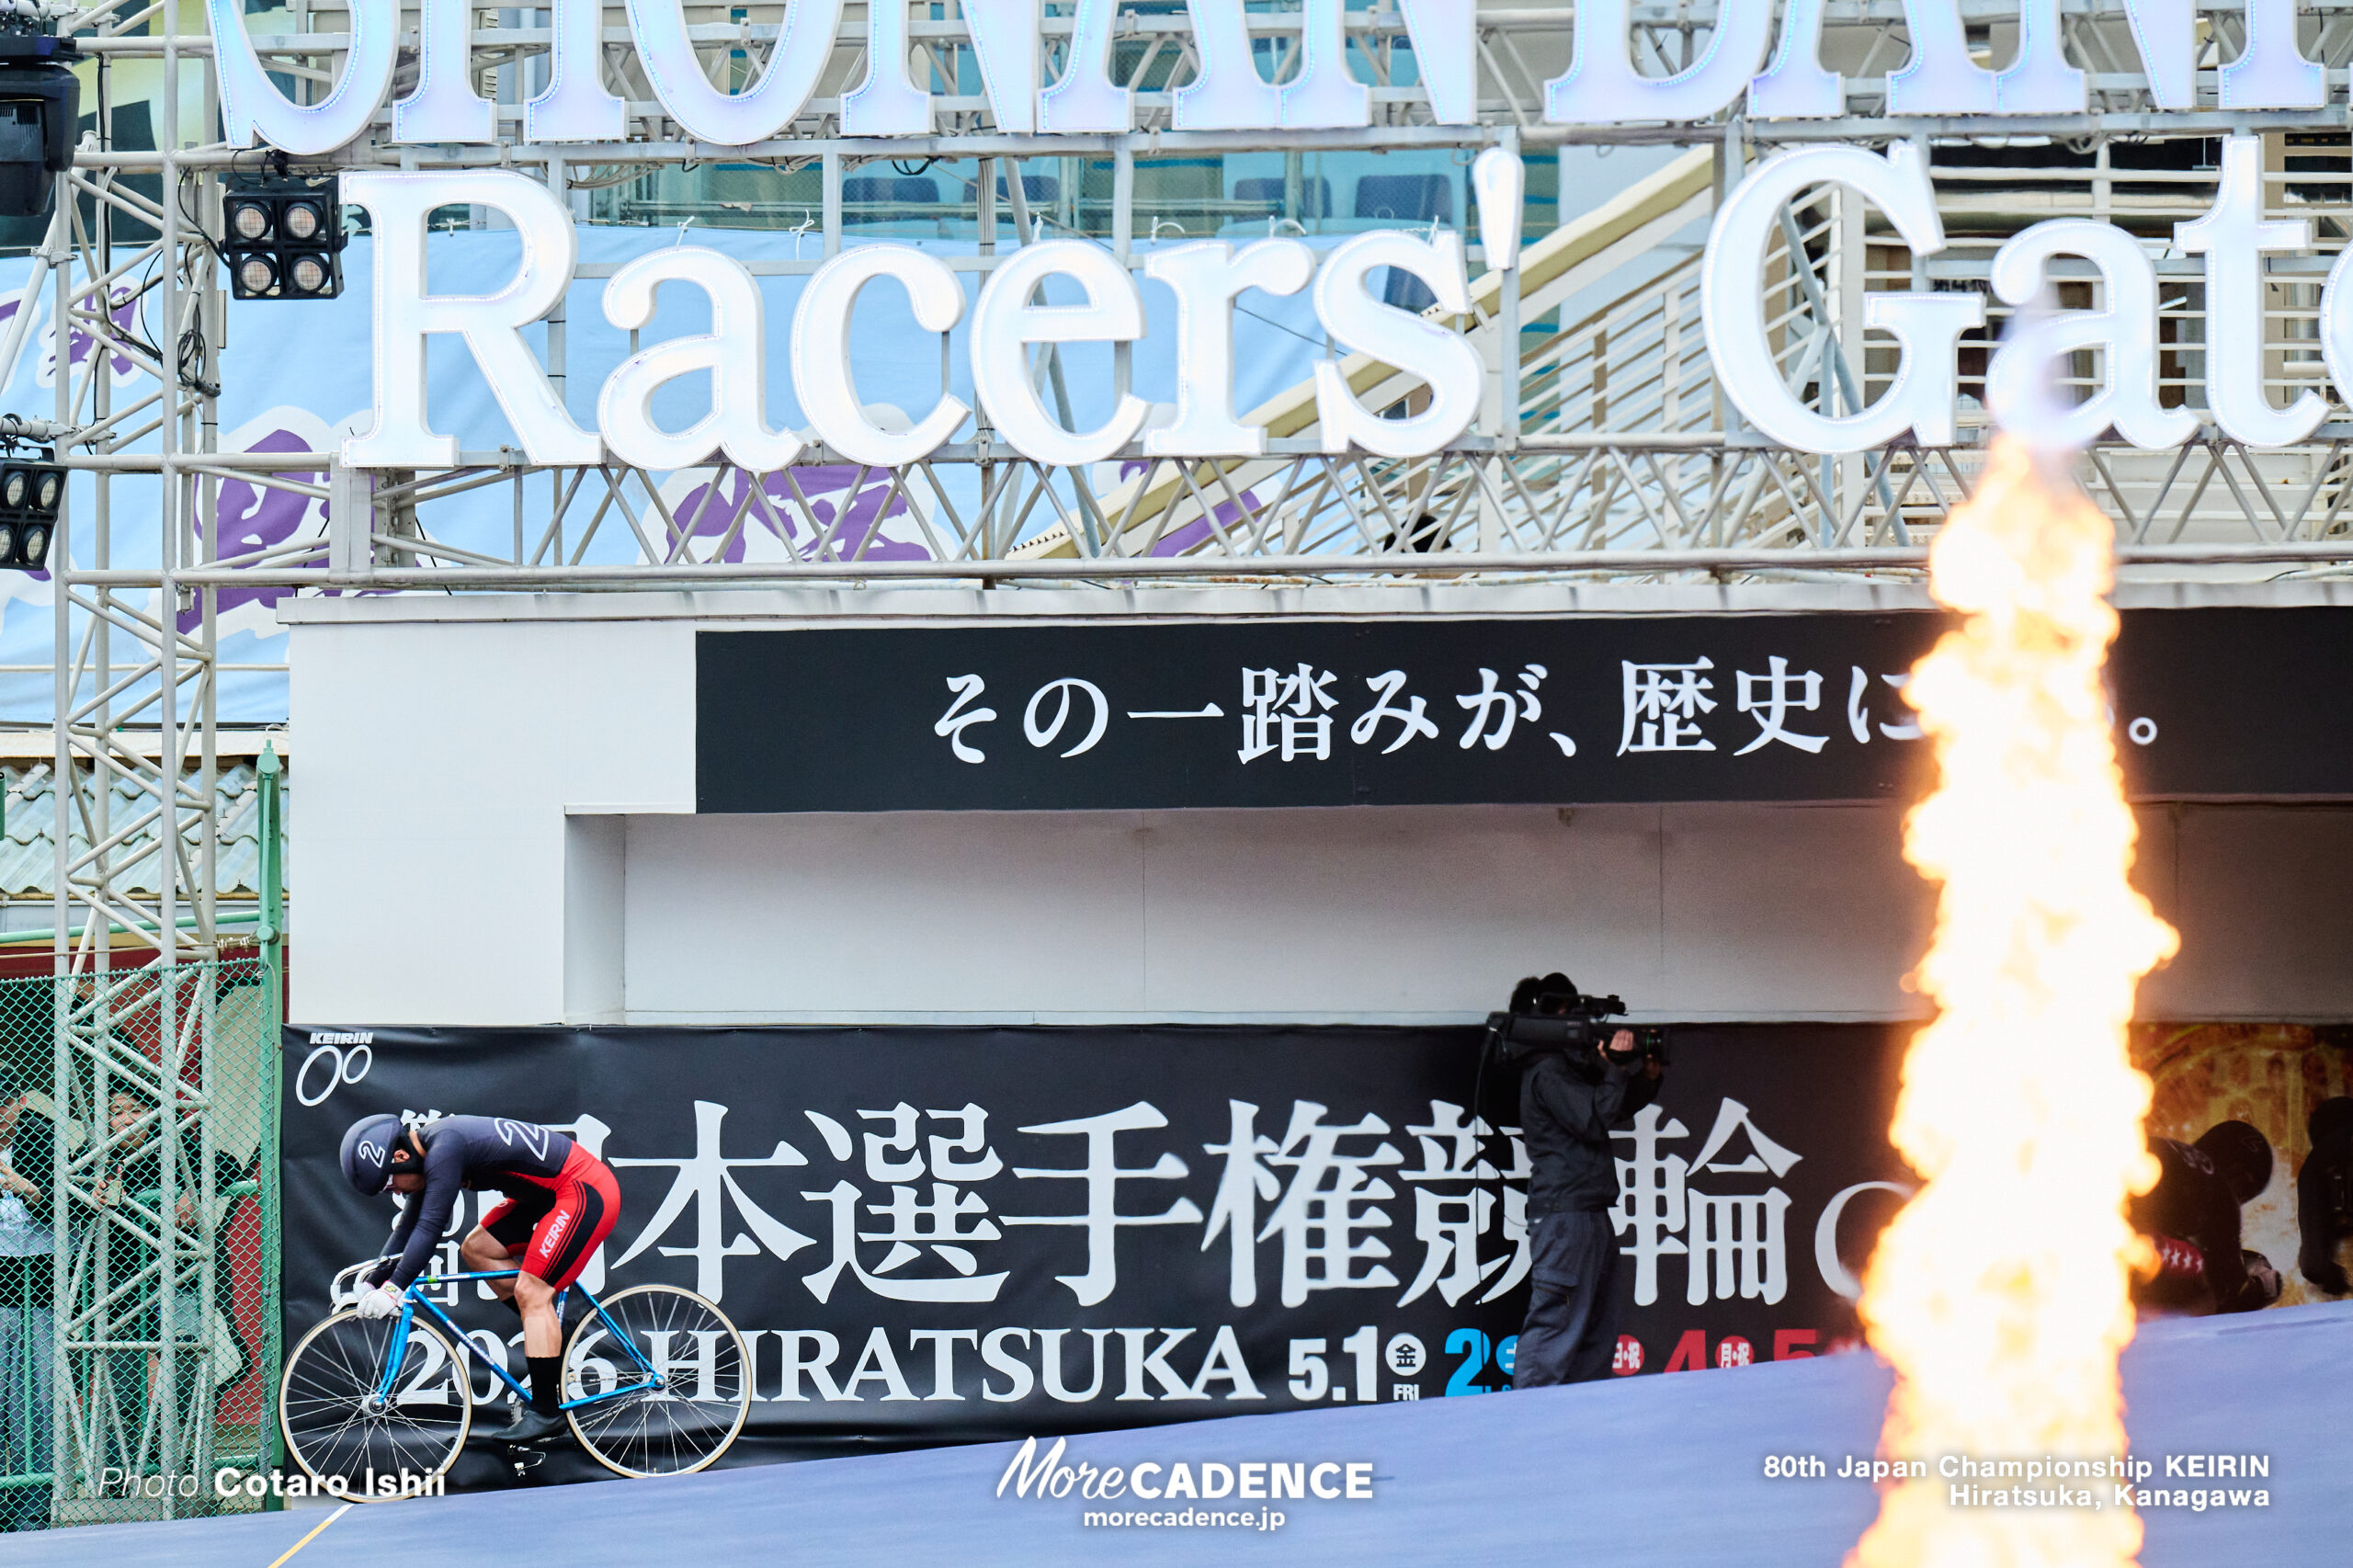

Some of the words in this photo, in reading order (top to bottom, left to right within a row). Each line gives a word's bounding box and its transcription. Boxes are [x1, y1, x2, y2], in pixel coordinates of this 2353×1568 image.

[339, 147, 1525, 472] Racers'
[1700, 135, 2353, 453] Gat
[935, 655, 2157, 765] その一踏みが、歴史に。
[310, 1032, 373, 1044] KEIRIN
[358, 1141, 386, 1168] 2
[494, 1117, 549, 1162] 2
[539, 1210, 571, 1258] KEIRIN
[397, 1328, 618, 1406] 206
[641, 1325, 1267, 1403] HIRATSUKA
[1289, 1326, 1378, 1402] 5.1
[1444, 1328, 1491, 1397] 2
[1393, 1383, 1420, 1402] FRI
